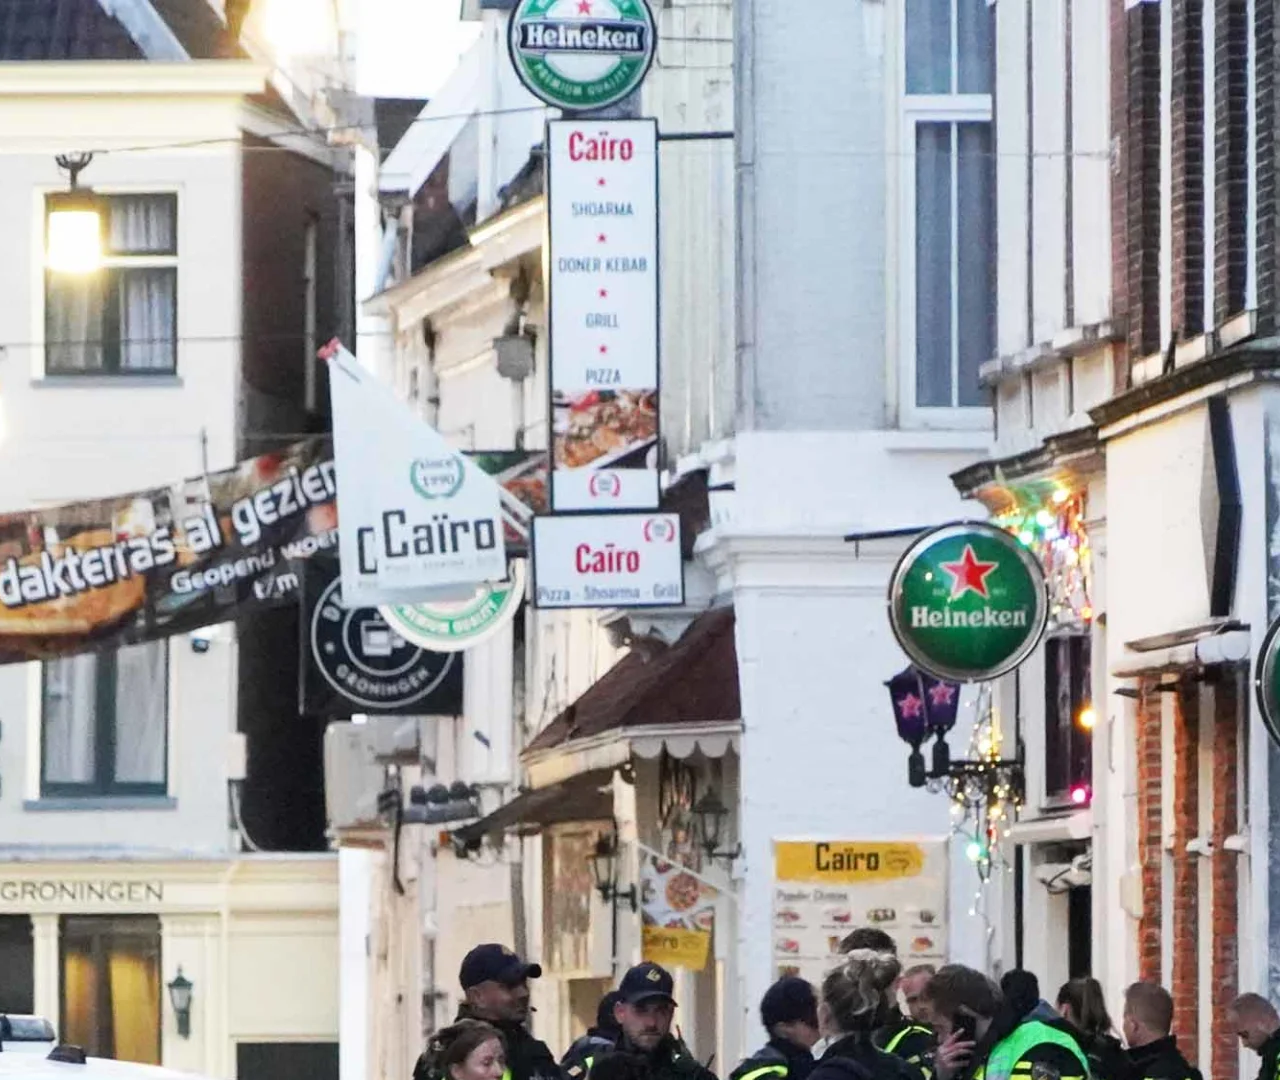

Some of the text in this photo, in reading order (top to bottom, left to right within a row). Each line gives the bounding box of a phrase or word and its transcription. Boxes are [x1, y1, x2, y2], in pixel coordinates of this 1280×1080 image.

[526, 24, 639, 49] Heineken
[569, 131, 634, 161] Caïro
[572, 202, 634, 216] SHOARMA
[606, 257, 647, 272] KEBAB
[586, 313, 618, 328] GRILL
[586, 369, 621, 384] PIZZA
[185, 503, 221, 553] al
[382, 509, 496, 558] Caïro
[171, 546, 275, 594] Geopend
[575, 543, 640, 573] Caïro
[539, 586, 570, 600] Pizza
[584, 584, 640, 600] Shoarma
[911, 606, 1026, 627] Heineken
[336, 663, 429, 696] GRONINGEN
[815, 842, 880, 872] Caïro
[0, 880, 164, 902] GRONINGEN
